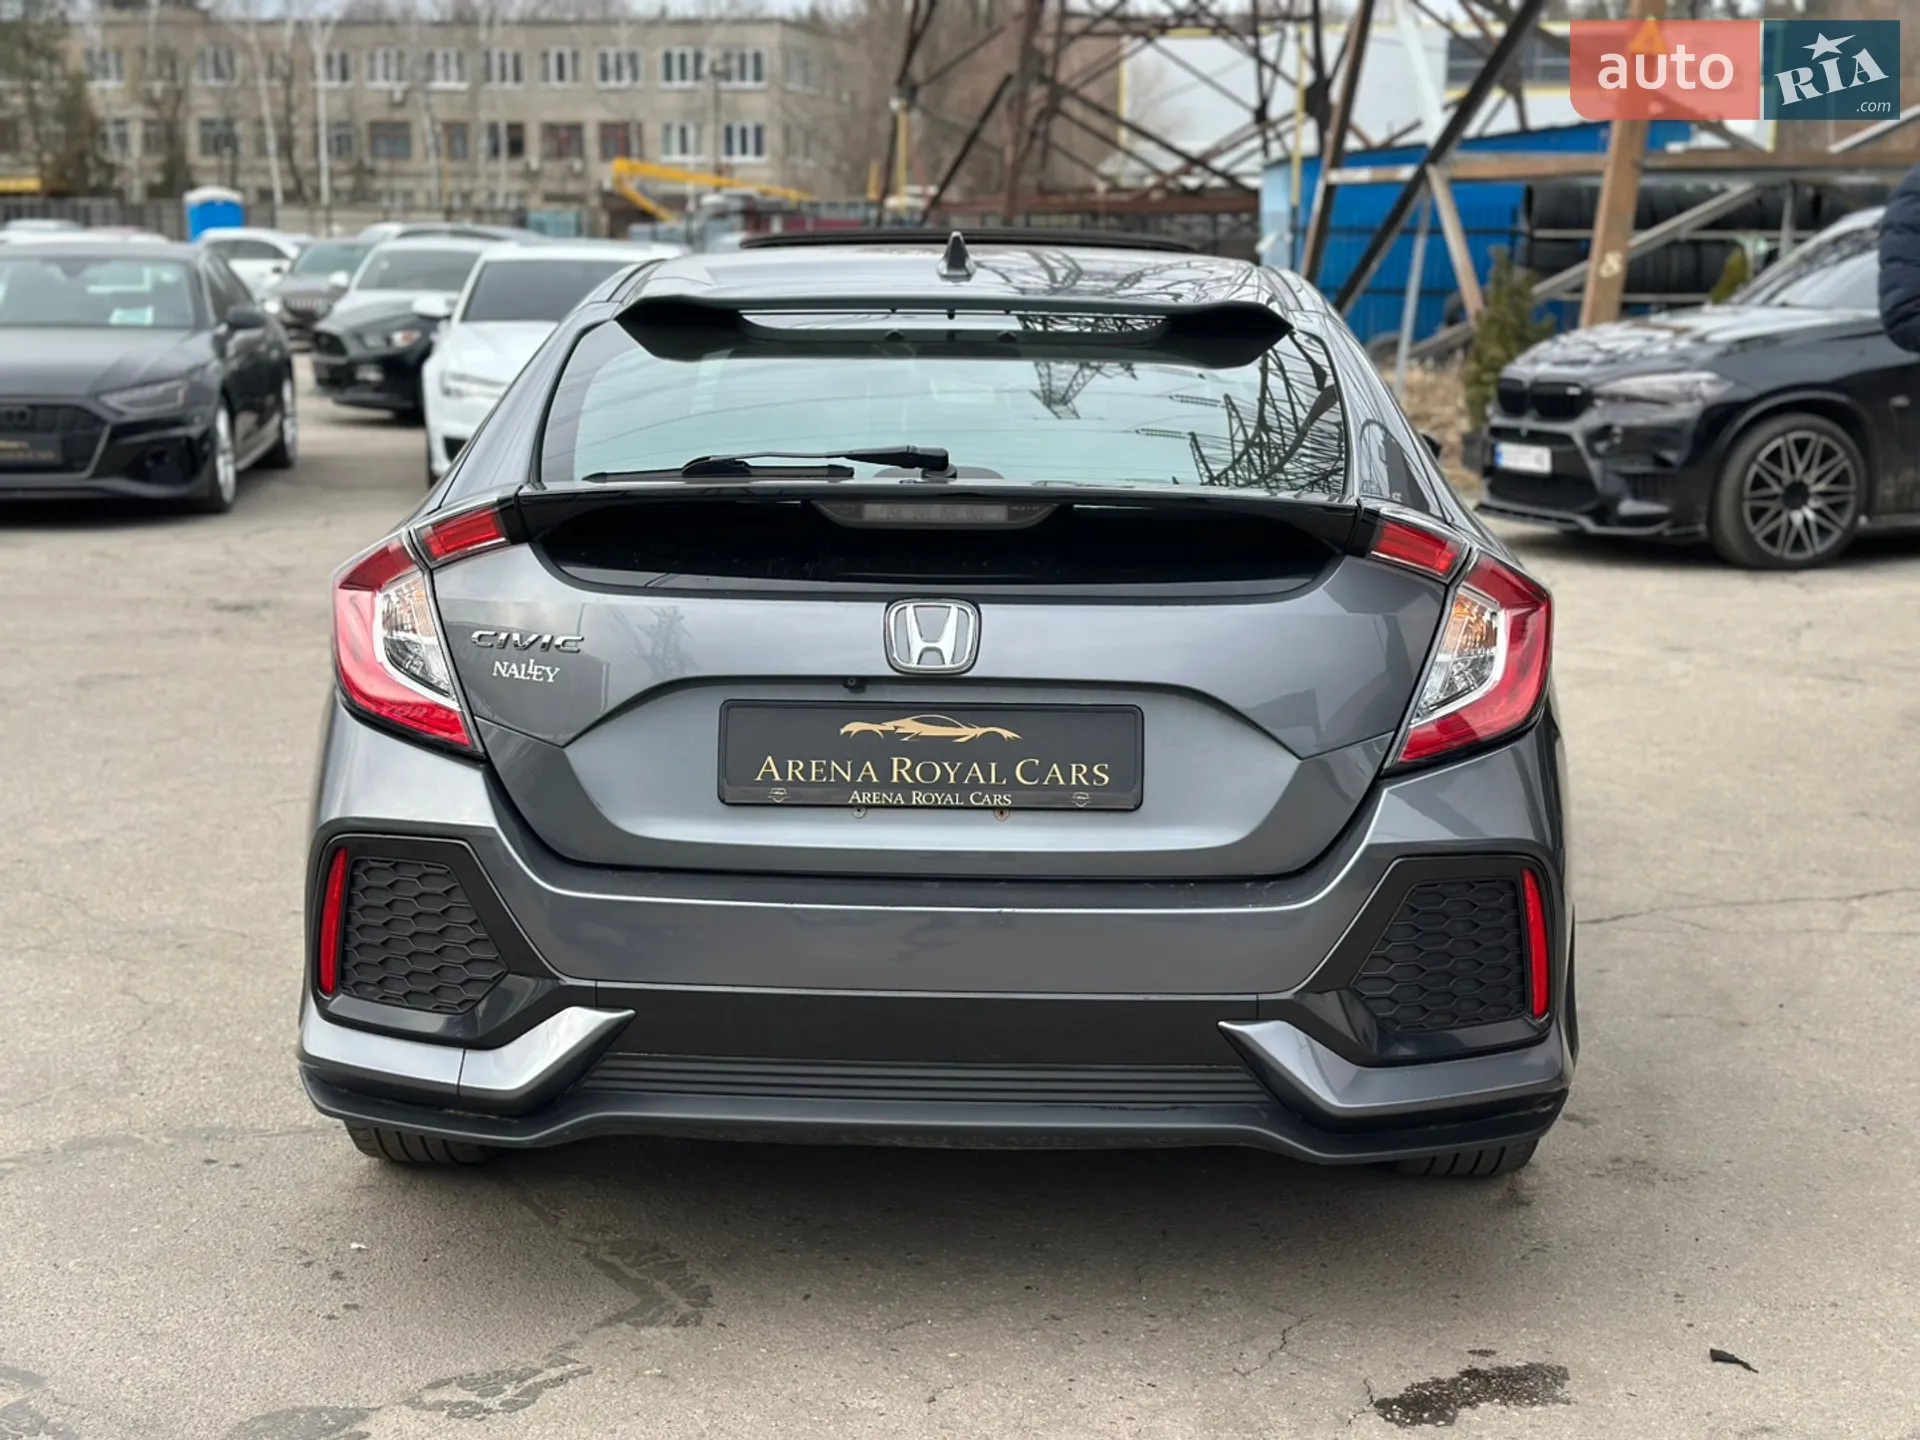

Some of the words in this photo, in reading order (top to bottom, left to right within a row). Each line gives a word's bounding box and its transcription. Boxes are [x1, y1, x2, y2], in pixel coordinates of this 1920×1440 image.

[471, 630, 584, 653] CIVIC
[492, 658, 561, 683] NALLEY
[754, 754, 879, 783] ARENA
[890, 756, 1007, 785] ROYAL
[1014, 757, 1110, 787] CARS
[848, 790, 904, 805] ARENA
[911, 790, 963, 806] ROYAL
[970, 790, 1012, 806] CARS
